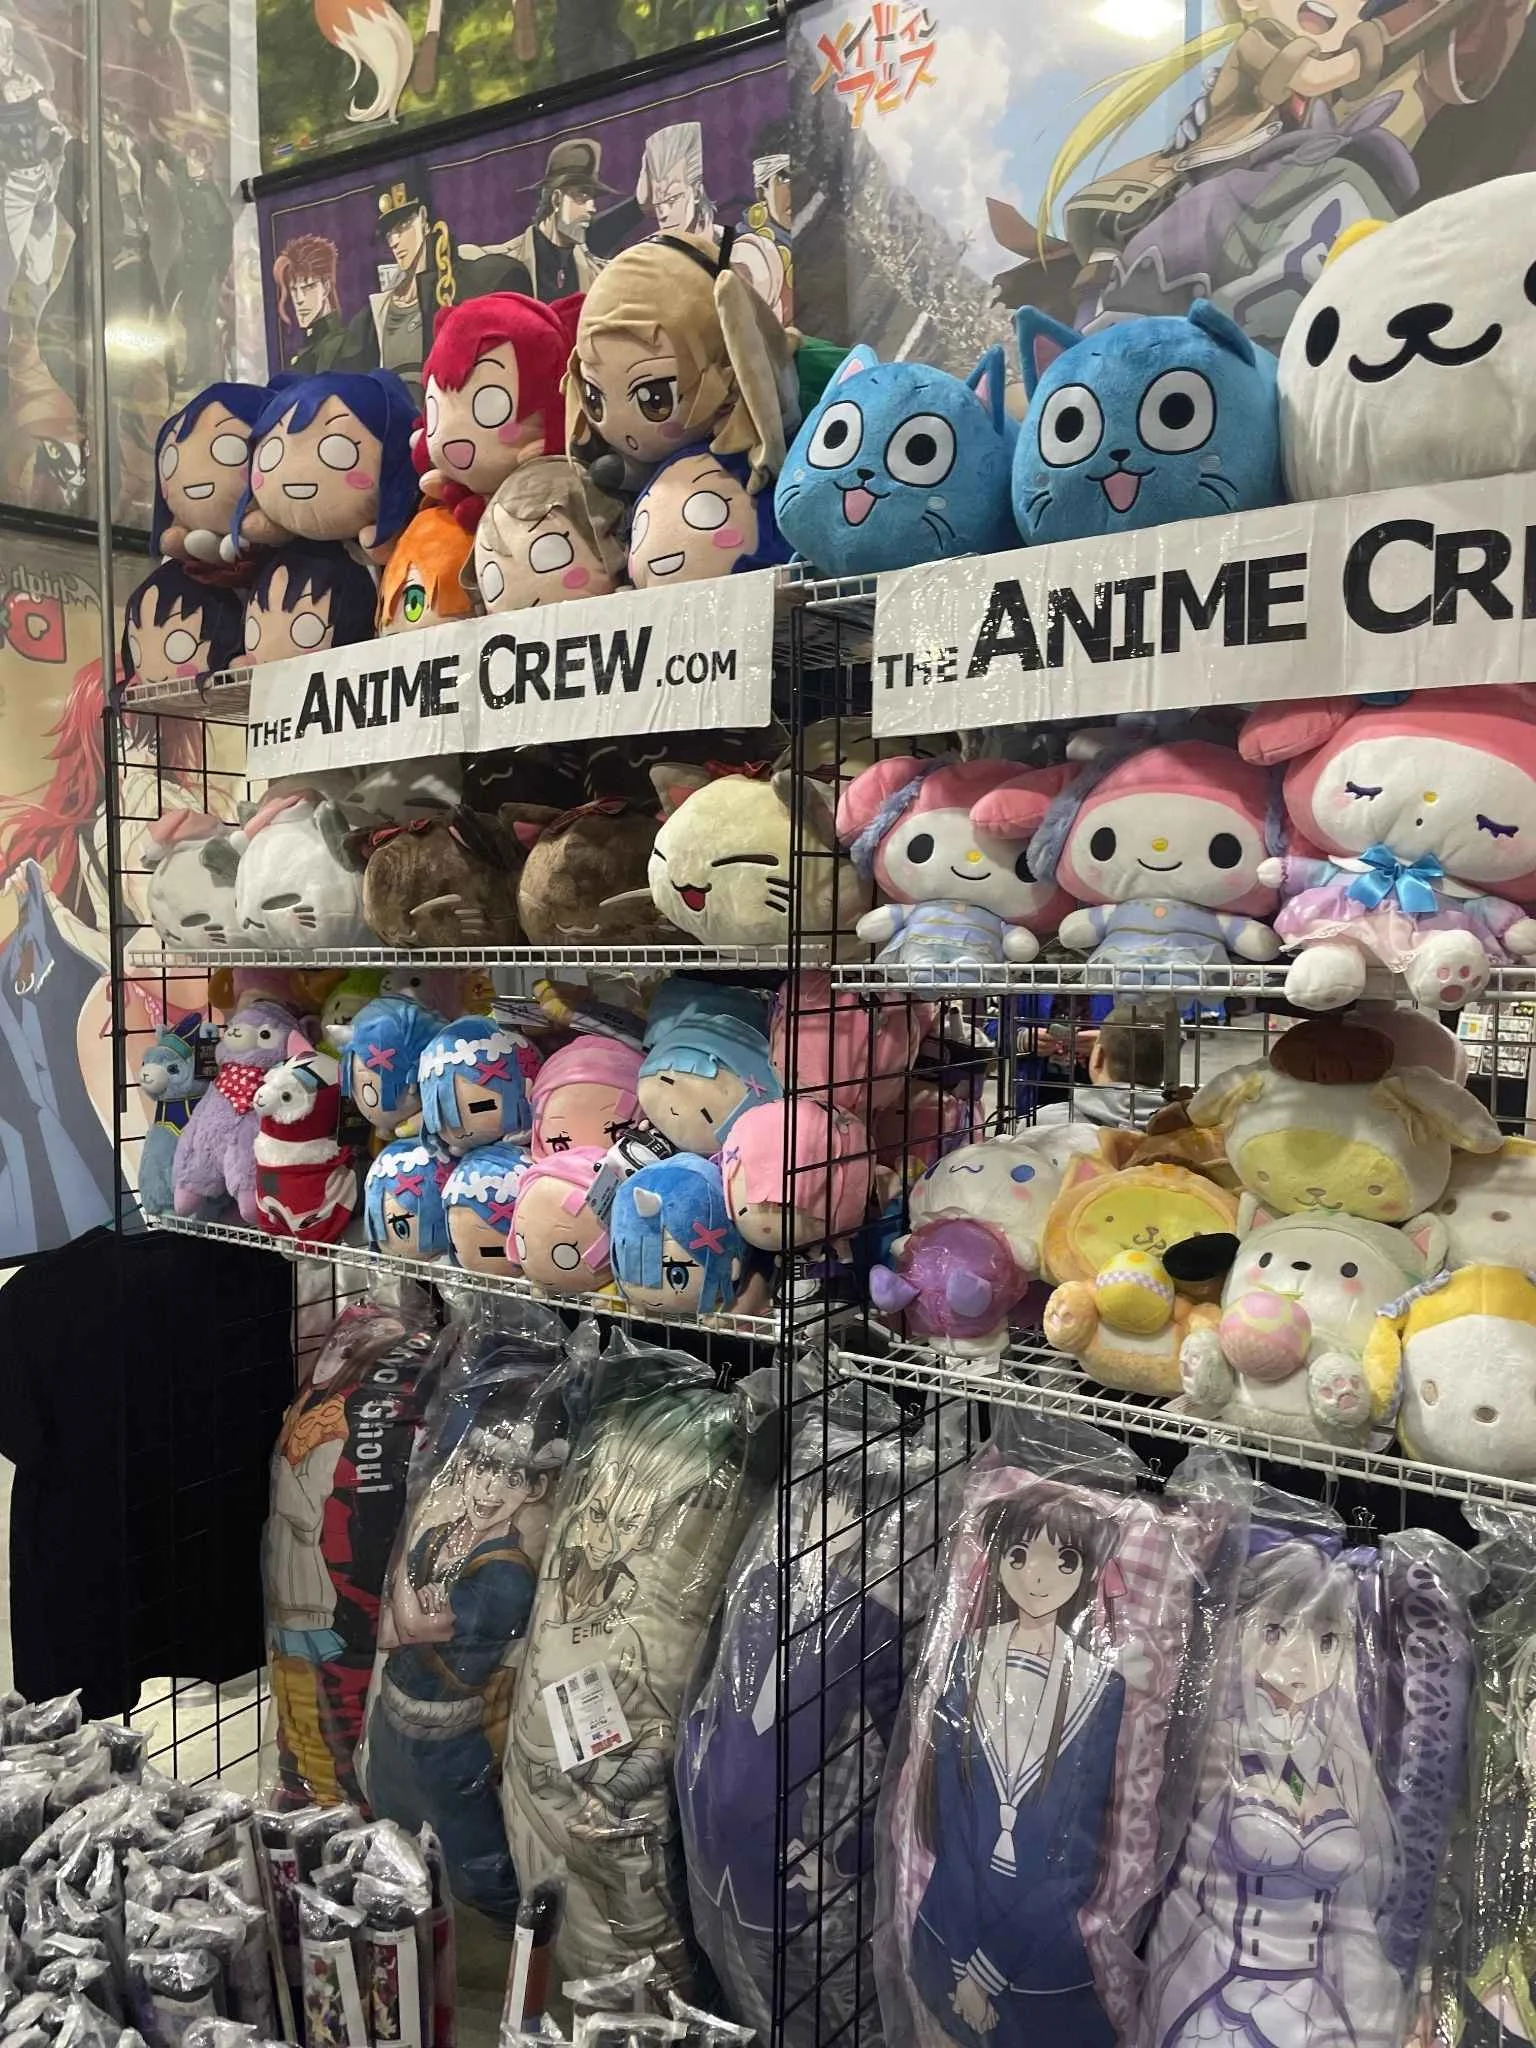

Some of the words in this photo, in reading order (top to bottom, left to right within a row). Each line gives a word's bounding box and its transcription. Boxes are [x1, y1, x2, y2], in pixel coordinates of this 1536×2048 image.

[810, 3, 938, 95] メイドイン
[835, 42, 938, 129] アビス
[877, 646, 959, 689] THE
[965, 552, 1307, 679] ANIME
[1343, 519, 1536, 634] CR
[250, 717, 292, 747] THE
[294, 654, 460, 740] ANIME
[355, 1397, 399, 1494] Ghoul
